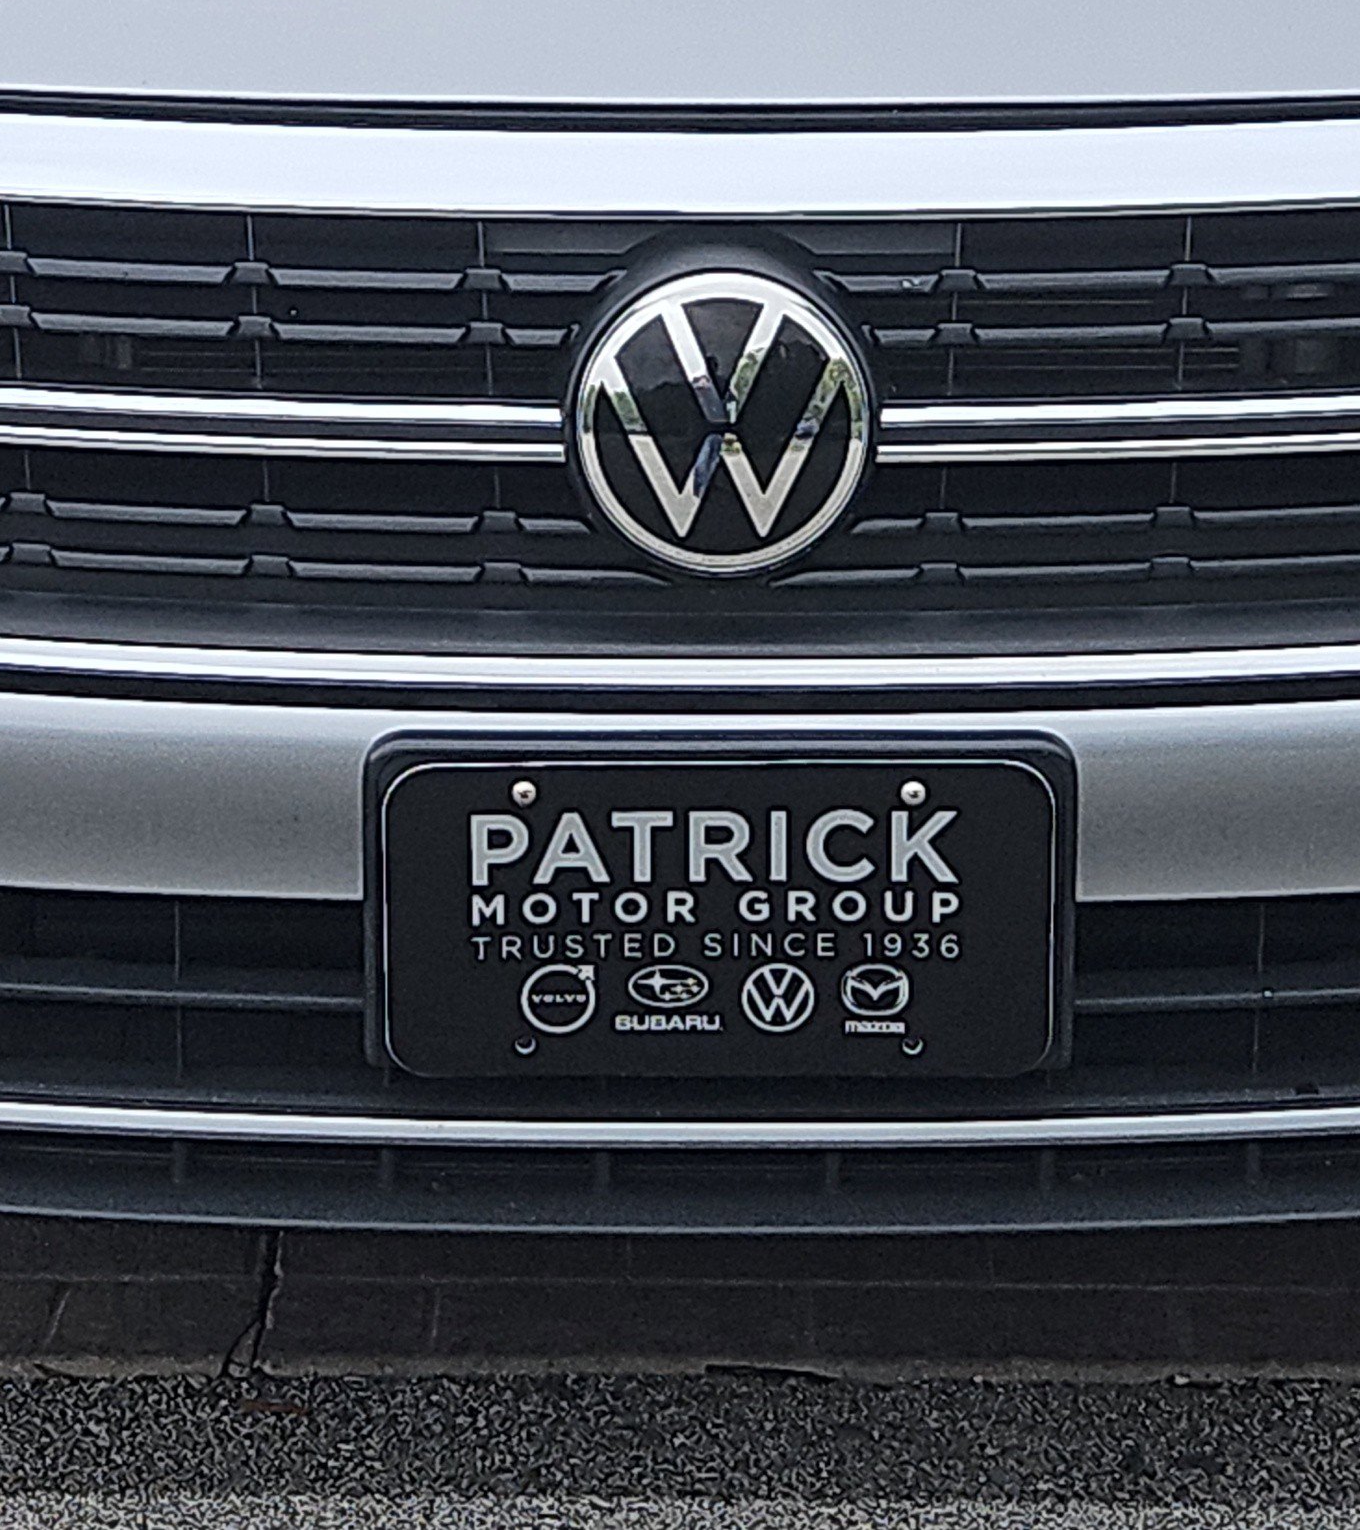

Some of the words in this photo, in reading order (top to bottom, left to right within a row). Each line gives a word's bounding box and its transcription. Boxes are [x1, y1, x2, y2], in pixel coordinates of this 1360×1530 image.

[470, 809, 960, 886] PATRICK
[472, 891, 696, 926] MOTOR
[739, 891, 960, 924] GROUP
[471, 933, 676, 961] TRUSTED
[703, 932, 836, 959] SINCE
[863, 931, 960, 959] 1936
[614, 1015, 721, 1031] SUBARU
